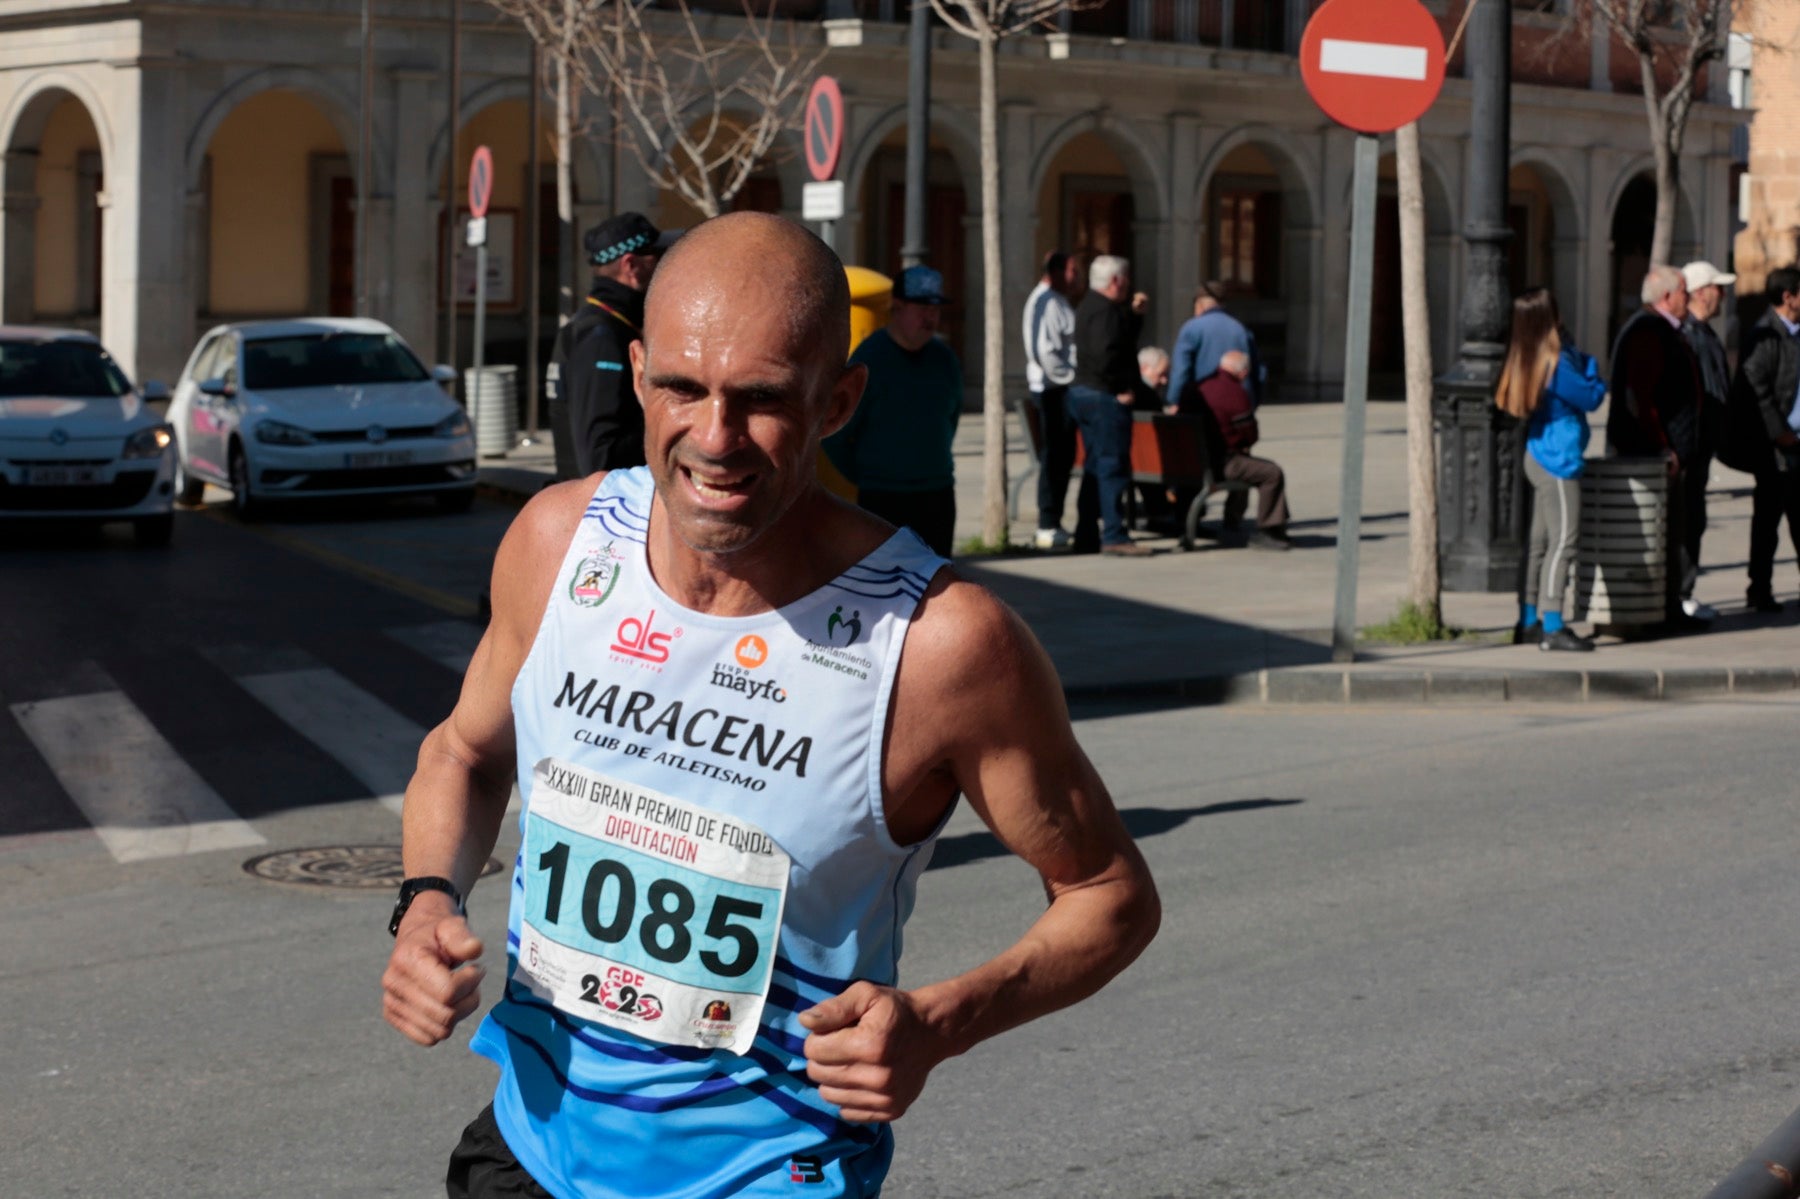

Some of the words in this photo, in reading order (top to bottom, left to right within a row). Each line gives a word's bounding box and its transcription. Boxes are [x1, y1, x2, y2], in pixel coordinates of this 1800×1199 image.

[710, 669, 787, 704] mayfo
[811, 652, 868, 680] Maracena
[553, 671, 813, 778] MARACENA
[574, 728, 620, 751] CLUB
[624, 743, 652, 760] DE
[652, 750, 767, 793] ATLETISMO
[547, 764, 588, 799] XXXIII
[590, 781, 633, 813] GRAN
[635, 795, 693, 834] PREMIO
[695, 816, 718, 841] DE
[605, 814, 699, 864] DIPUTACIÓN
[538, 841, 764, 979] 1085
